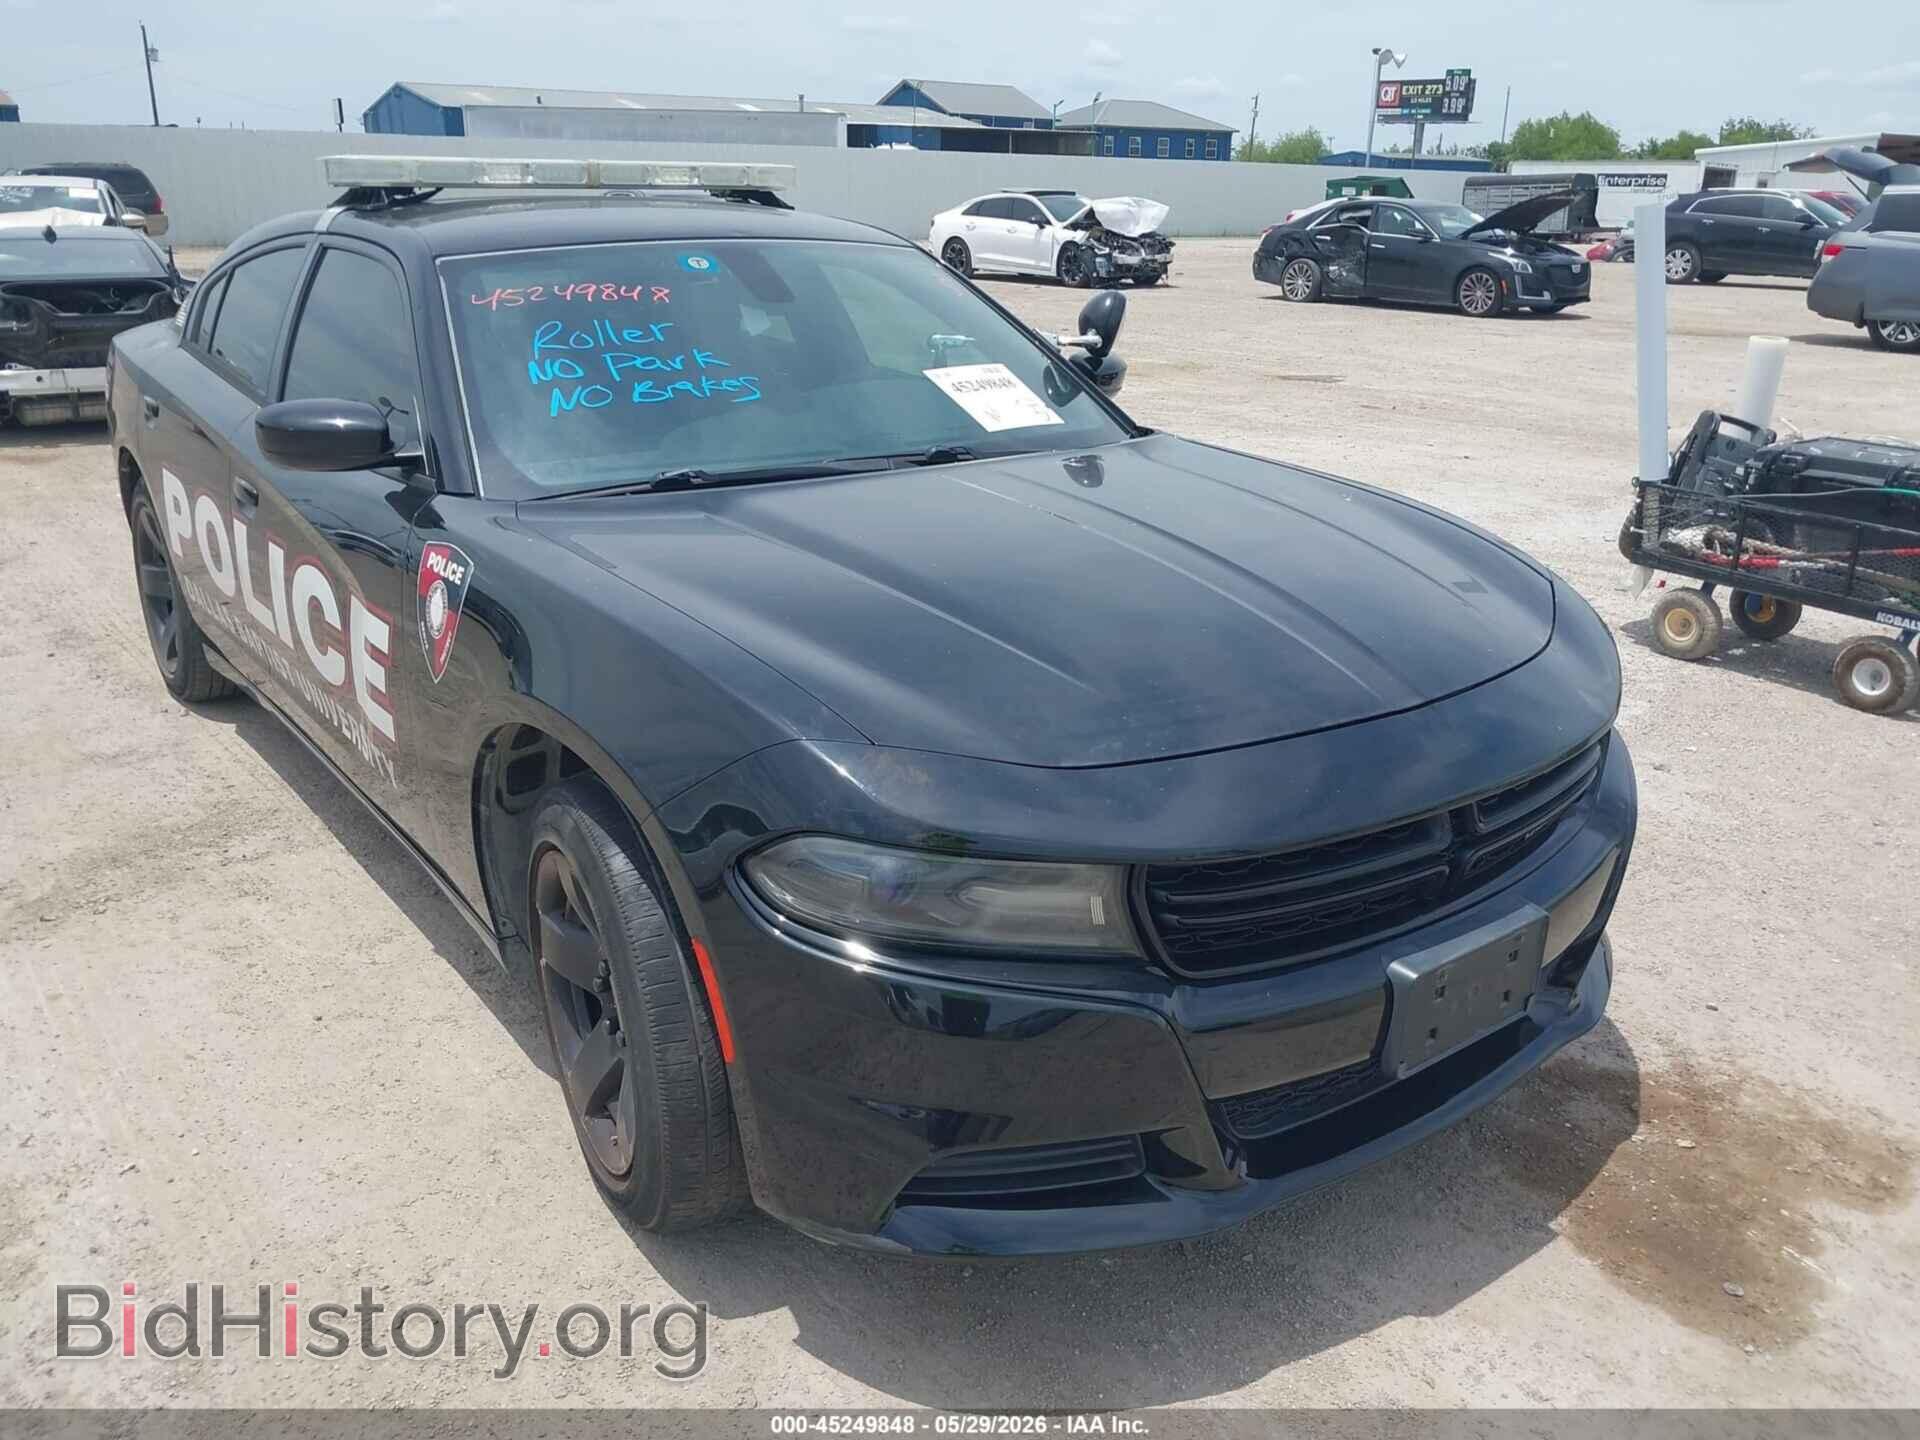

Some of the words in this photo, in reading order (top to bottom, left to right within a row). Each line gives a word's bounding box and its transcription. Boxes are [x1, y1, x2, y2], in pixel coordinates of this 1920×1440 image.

[1382, 87, 1396, 101] QT
[1402, 85, 1424, 95] EXIT
[1425, 84, 1443, 95] 273
[471, 283, 672, 311] 45249848
[533, 319, 673, 358] Roller
[528, 358, 584, 384] NO
[550, 385, 613, 417] NO
[427, 551, 465, 585] POLICE
[162, 467, 396, 742] POLICE
[1876, 611, 1920, 631] KOBAL
[295, 668, 398, 789] UNIVERSITY
